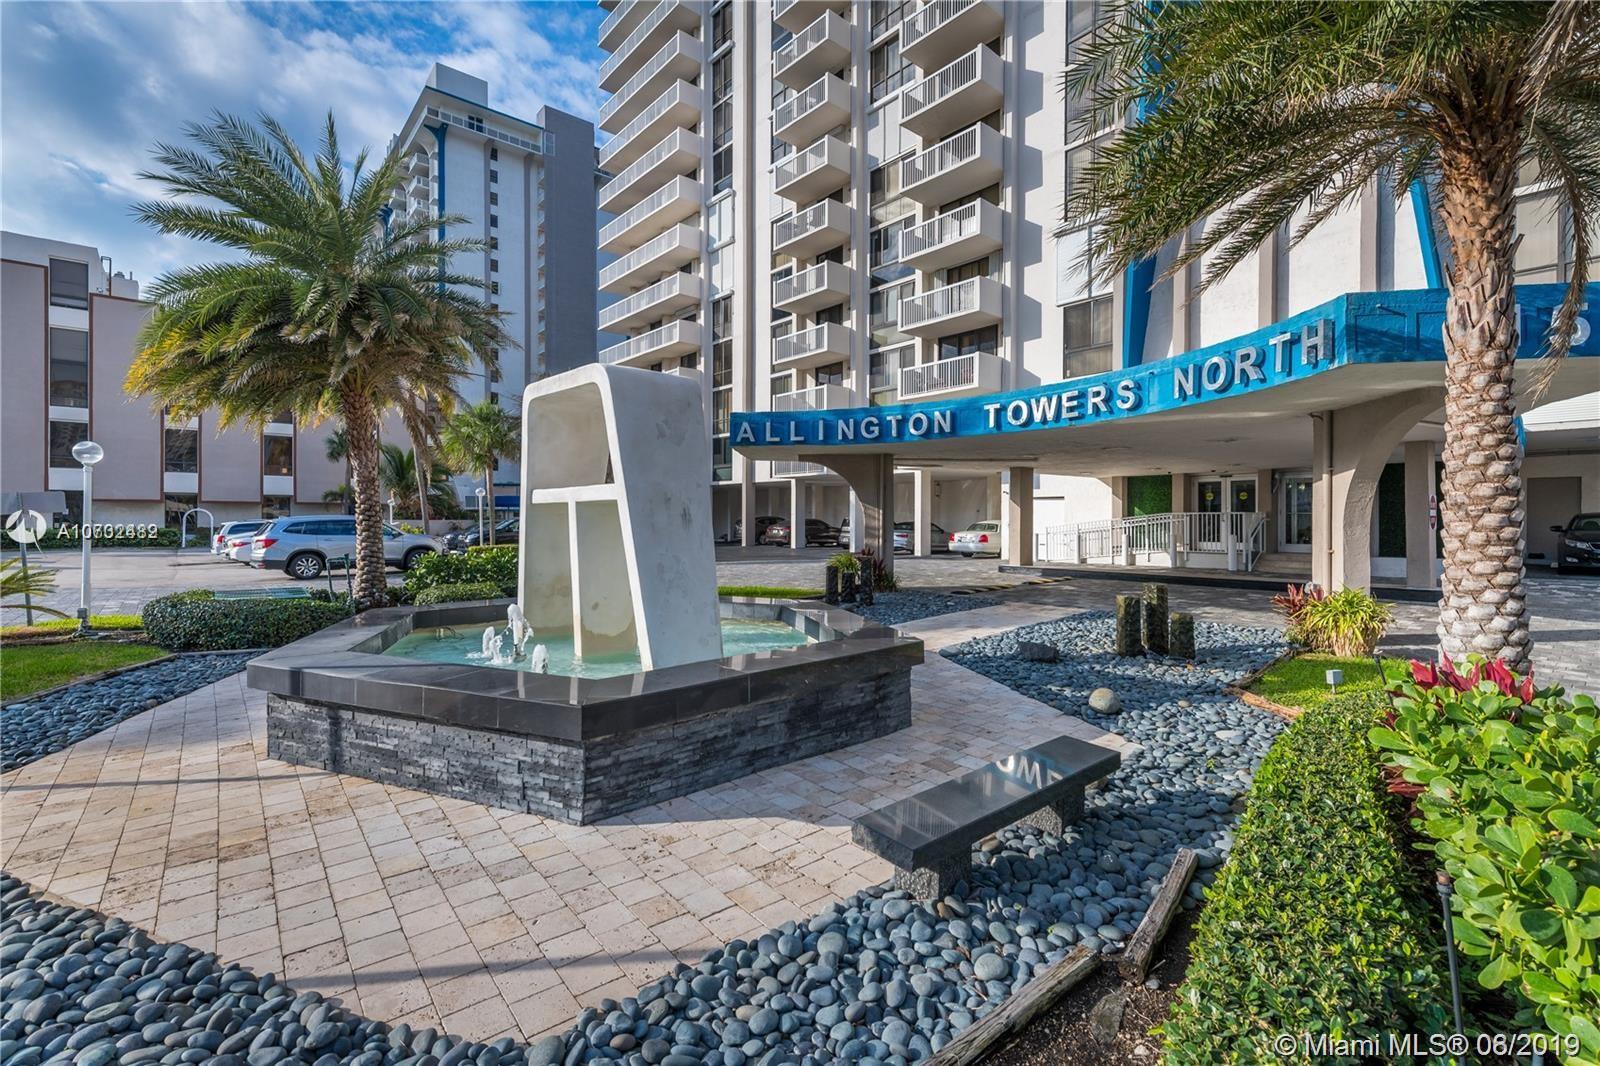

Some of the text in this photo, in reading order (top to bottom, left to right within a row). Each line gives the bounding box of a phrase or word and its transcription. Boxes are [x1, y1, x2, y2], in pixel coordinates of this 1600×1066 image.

[736, 320, 1333, 443] ALLINGTON TOWERS NORTH
